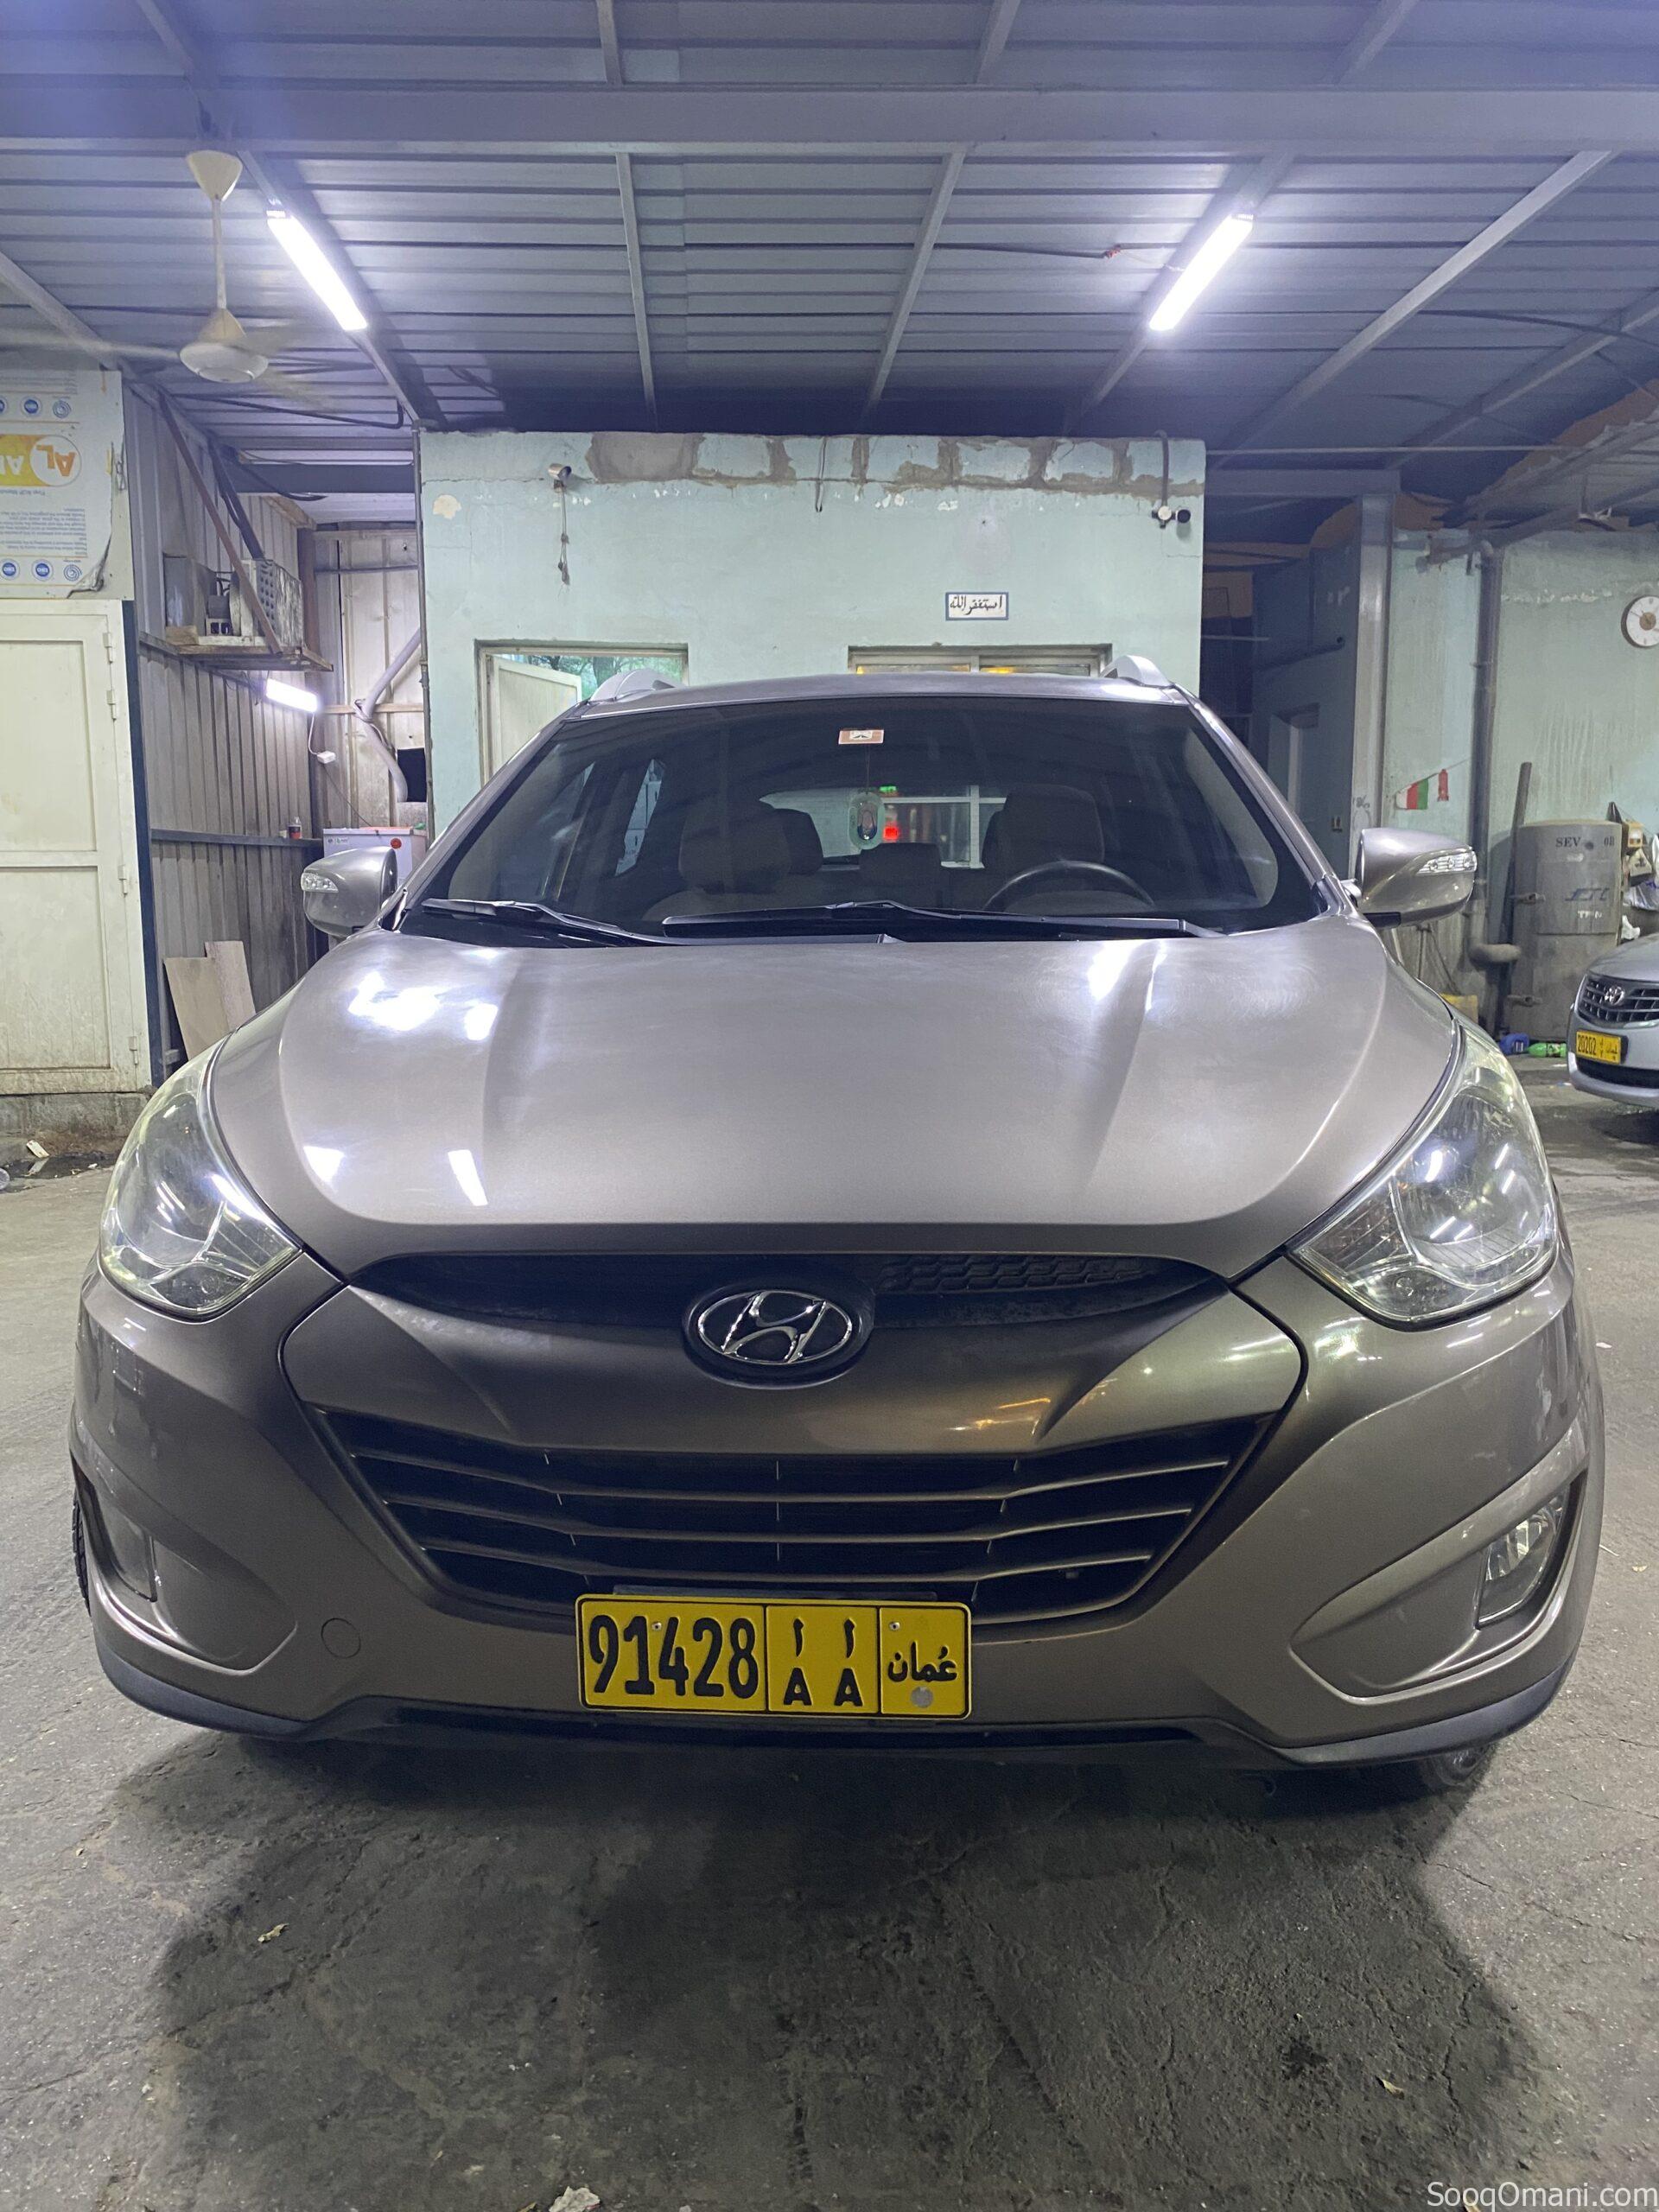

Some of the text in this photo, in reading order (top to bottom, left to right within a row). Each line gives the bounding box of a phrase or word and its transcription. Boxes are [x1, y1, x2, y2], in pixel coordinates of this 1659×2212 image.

[950, 594, 1002, 615] استغفر الله
[588, 1614, 759, 1700] 91428
